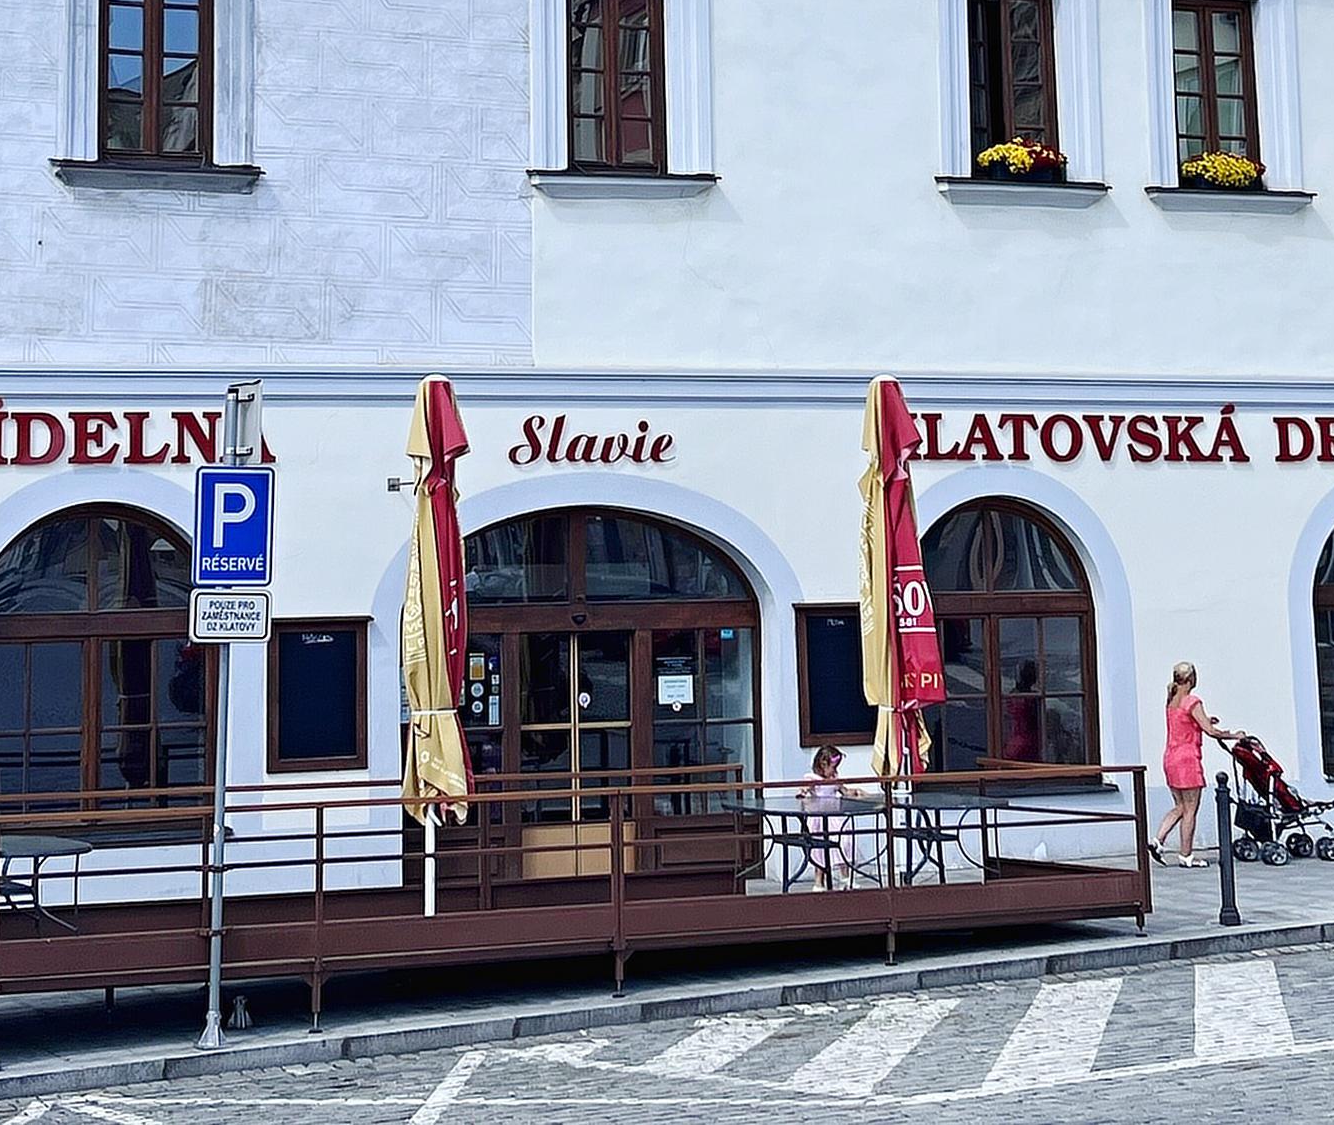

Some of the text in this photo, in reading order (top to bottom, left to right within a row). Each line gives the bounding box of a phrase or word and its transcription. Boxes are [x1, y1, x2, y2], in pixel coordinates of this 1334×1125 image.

[508, 414, 677, 465] Slavie
[212, 482, 256, 549] P
[201, 553, 264, 572] RÉSERVÉ
[238, 600, 255, 610] PRO
